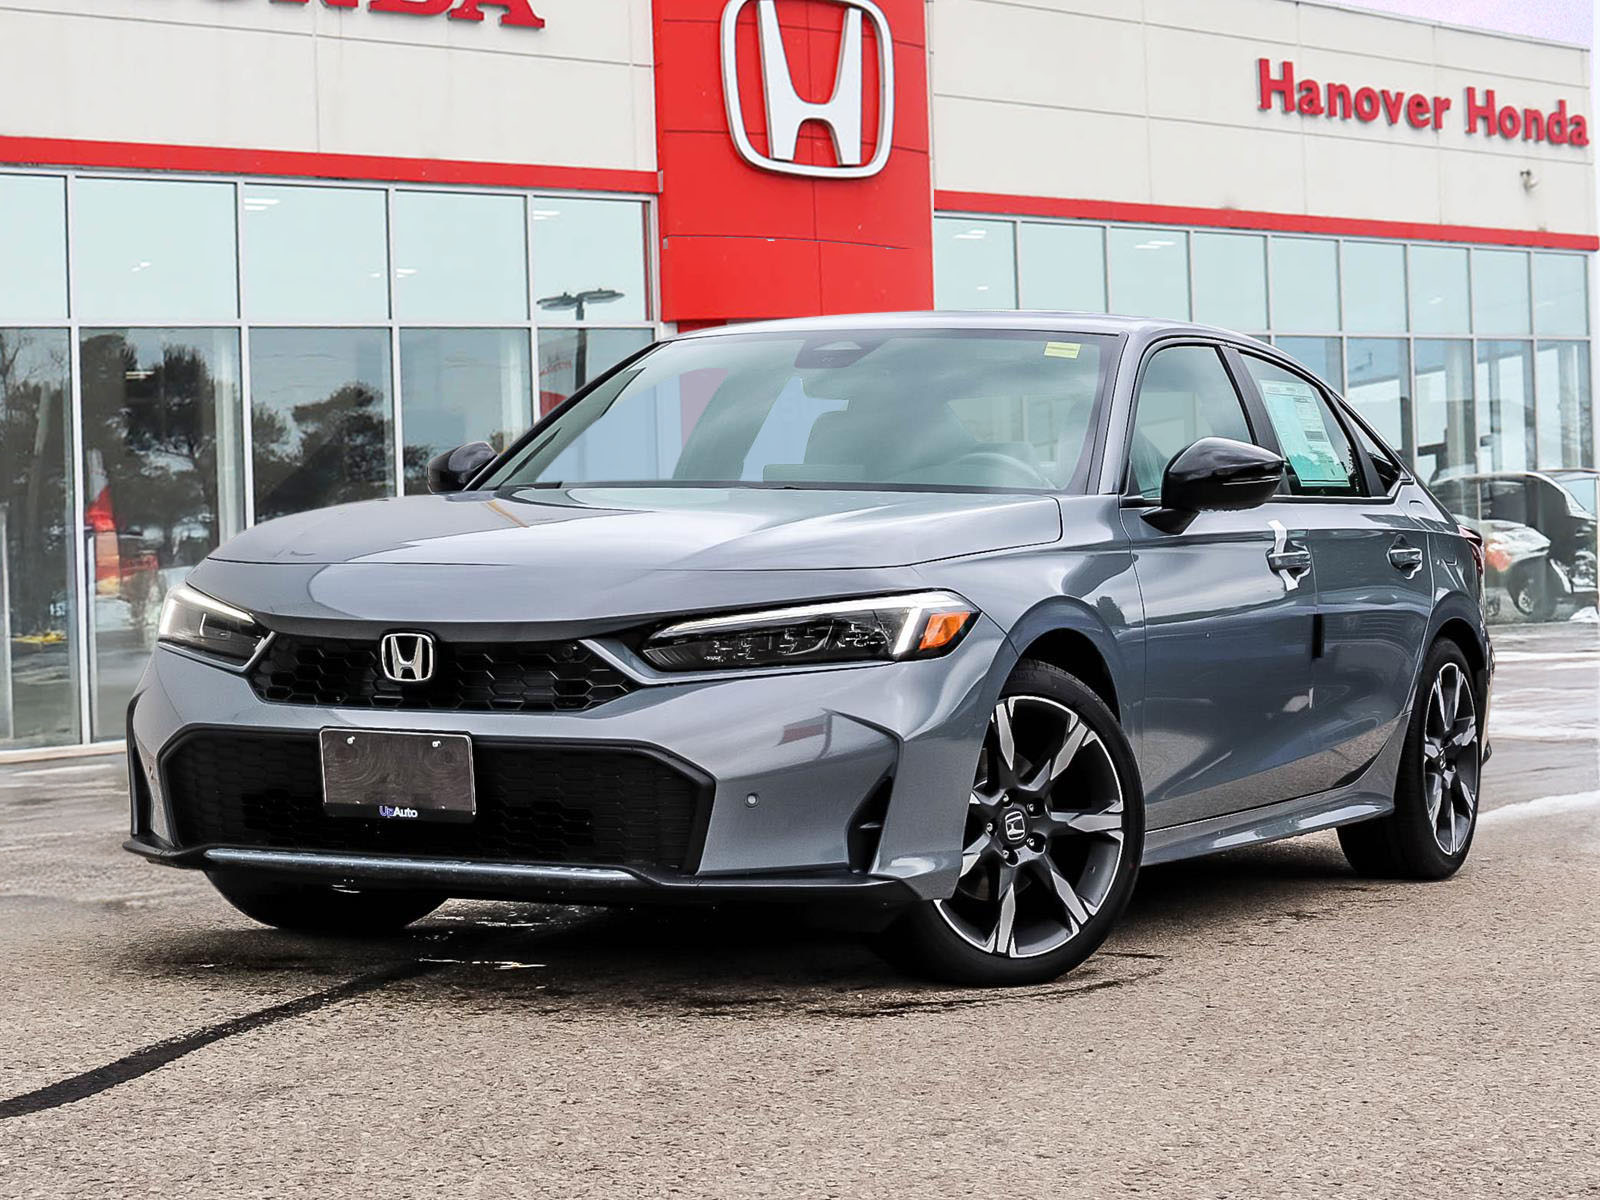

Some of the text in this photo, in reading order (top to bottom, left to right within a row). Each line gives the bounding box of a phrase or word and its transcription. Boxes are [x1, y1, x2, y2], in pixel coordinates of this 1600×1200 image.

[1257, 57, 1590, 147] Hanover Honda
[378, 805, 419, 819] UpAuto
